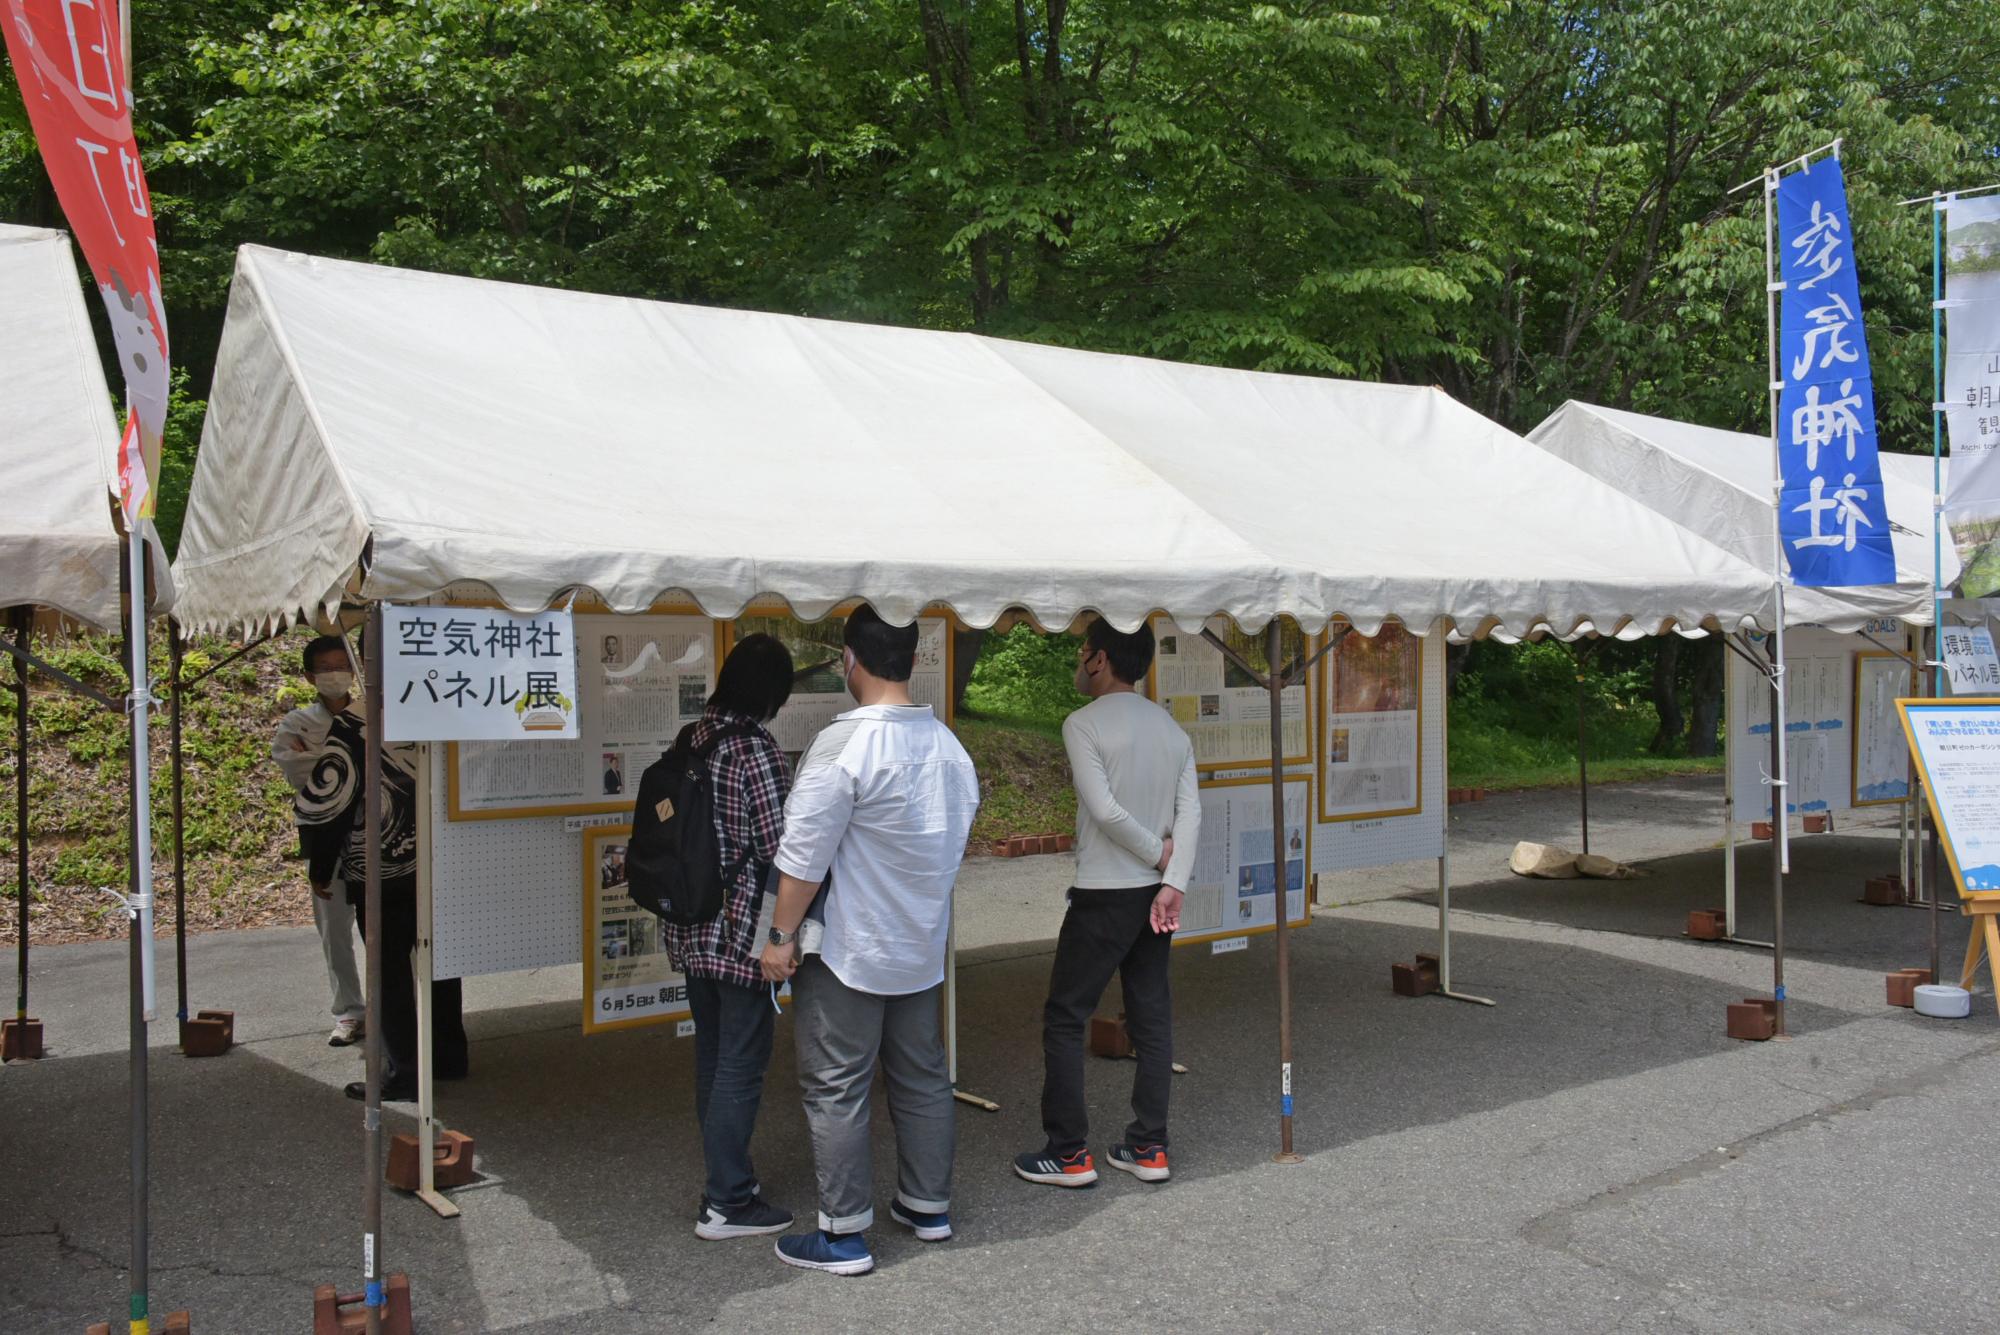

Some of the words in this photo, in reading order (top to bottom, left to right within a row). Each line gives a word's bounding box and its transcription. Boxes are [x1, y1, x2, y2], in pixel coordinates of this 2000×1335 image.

[1966, 386, 2000, 409] 朝
[1867, 618, 1896, 633] GOALS
[399, 617, 563, 659] 空気神社
[1944, 635, 1974, 656] 環境
[400, 669, 562, 709] パネル展
[602, 994, 655, 1011] 6月5日は
